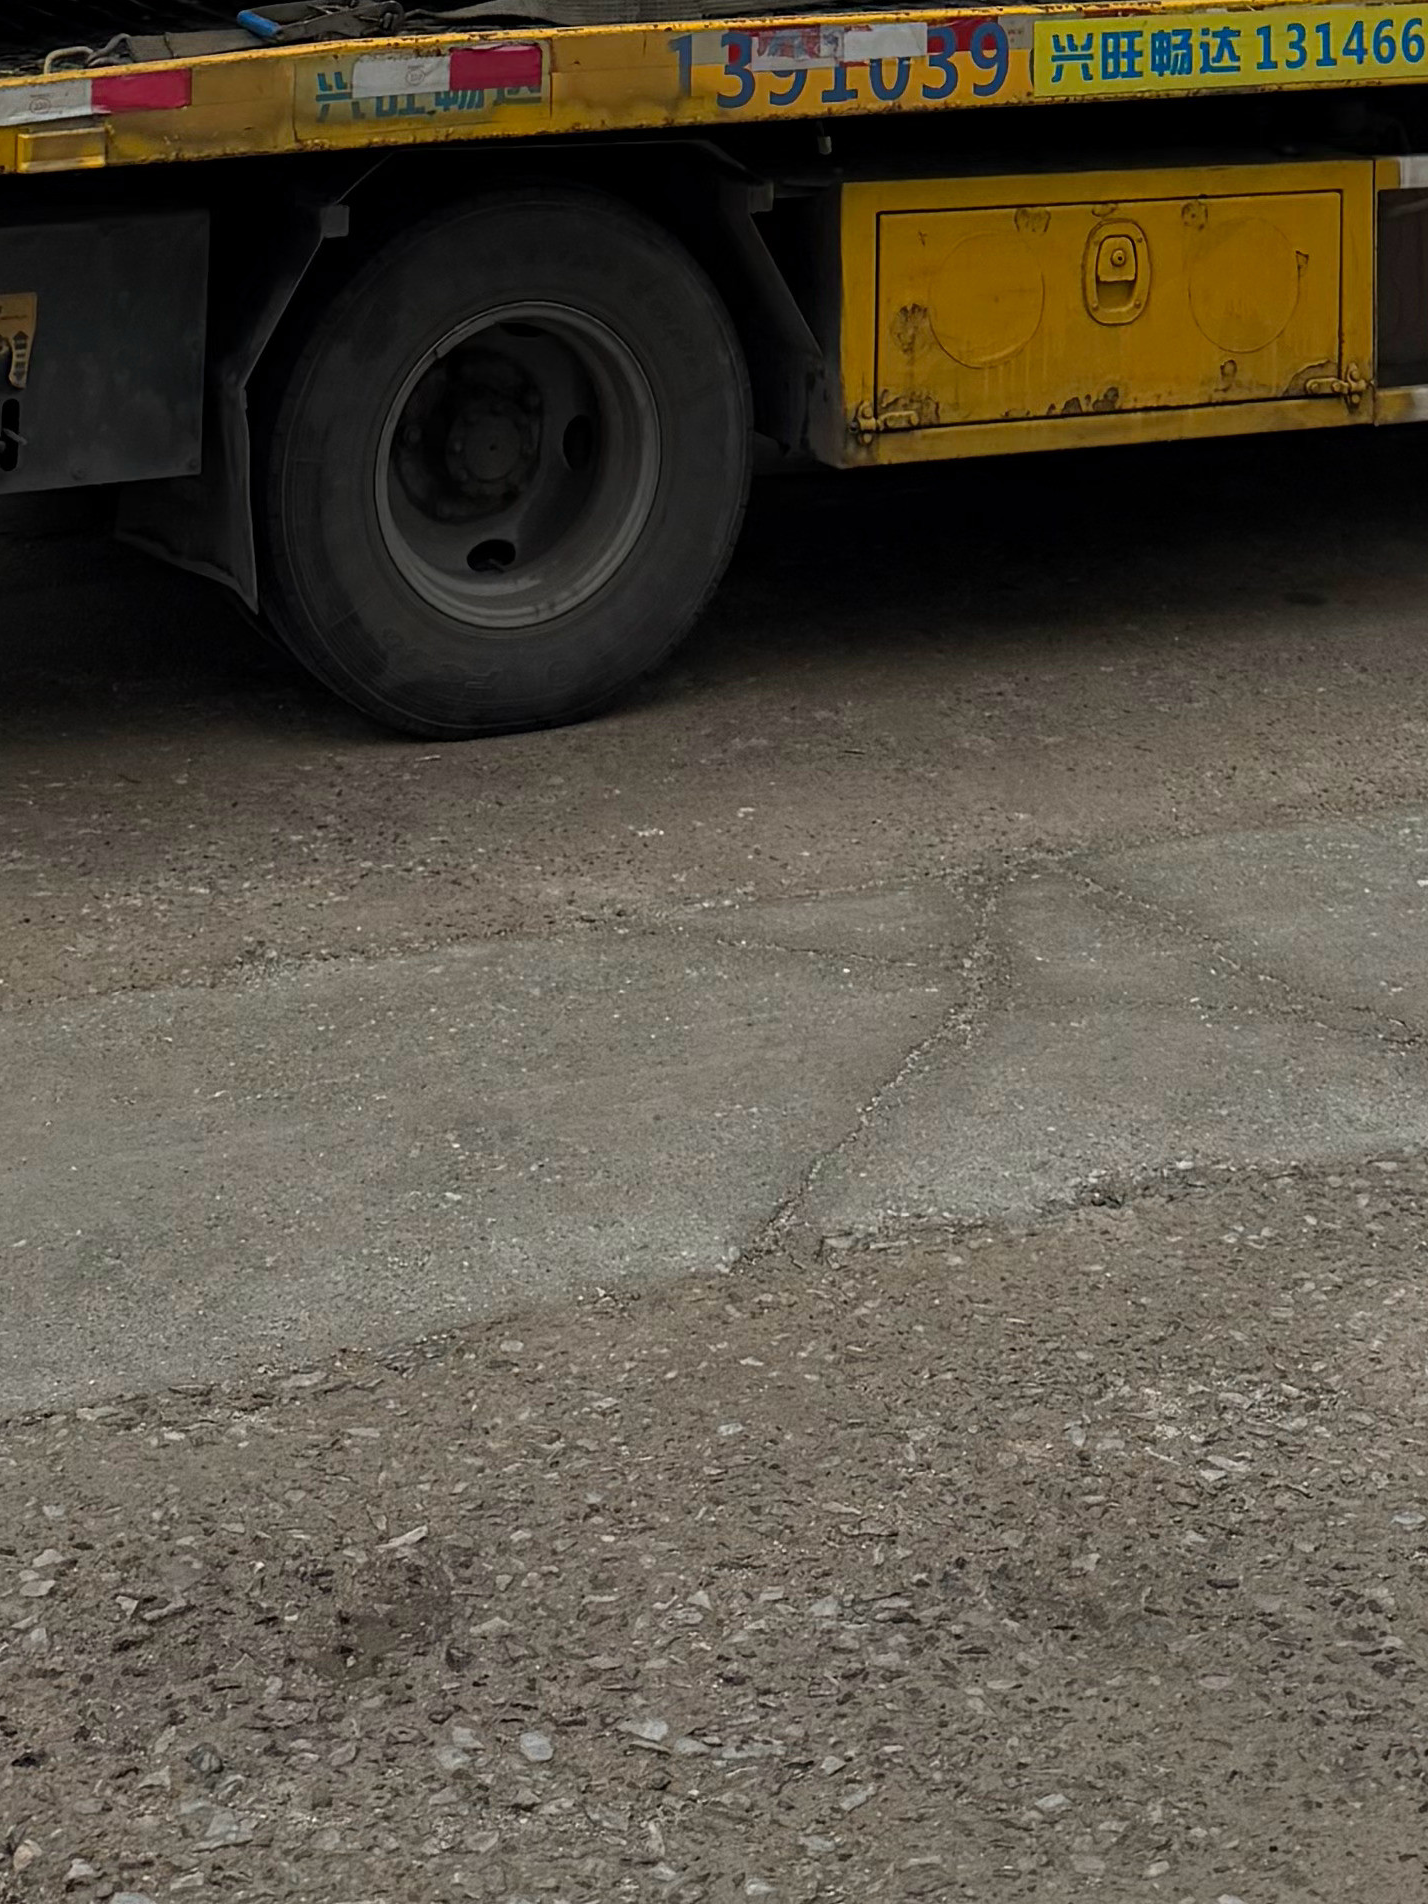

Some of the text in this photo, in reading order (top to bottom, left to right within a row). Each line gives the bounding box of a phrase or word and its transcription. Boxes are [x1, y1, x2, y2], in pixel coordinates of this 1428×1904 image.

[669, 21, 1034, 109] 1391039
[1051, 26, 1241, 84] 兴旺畅达
